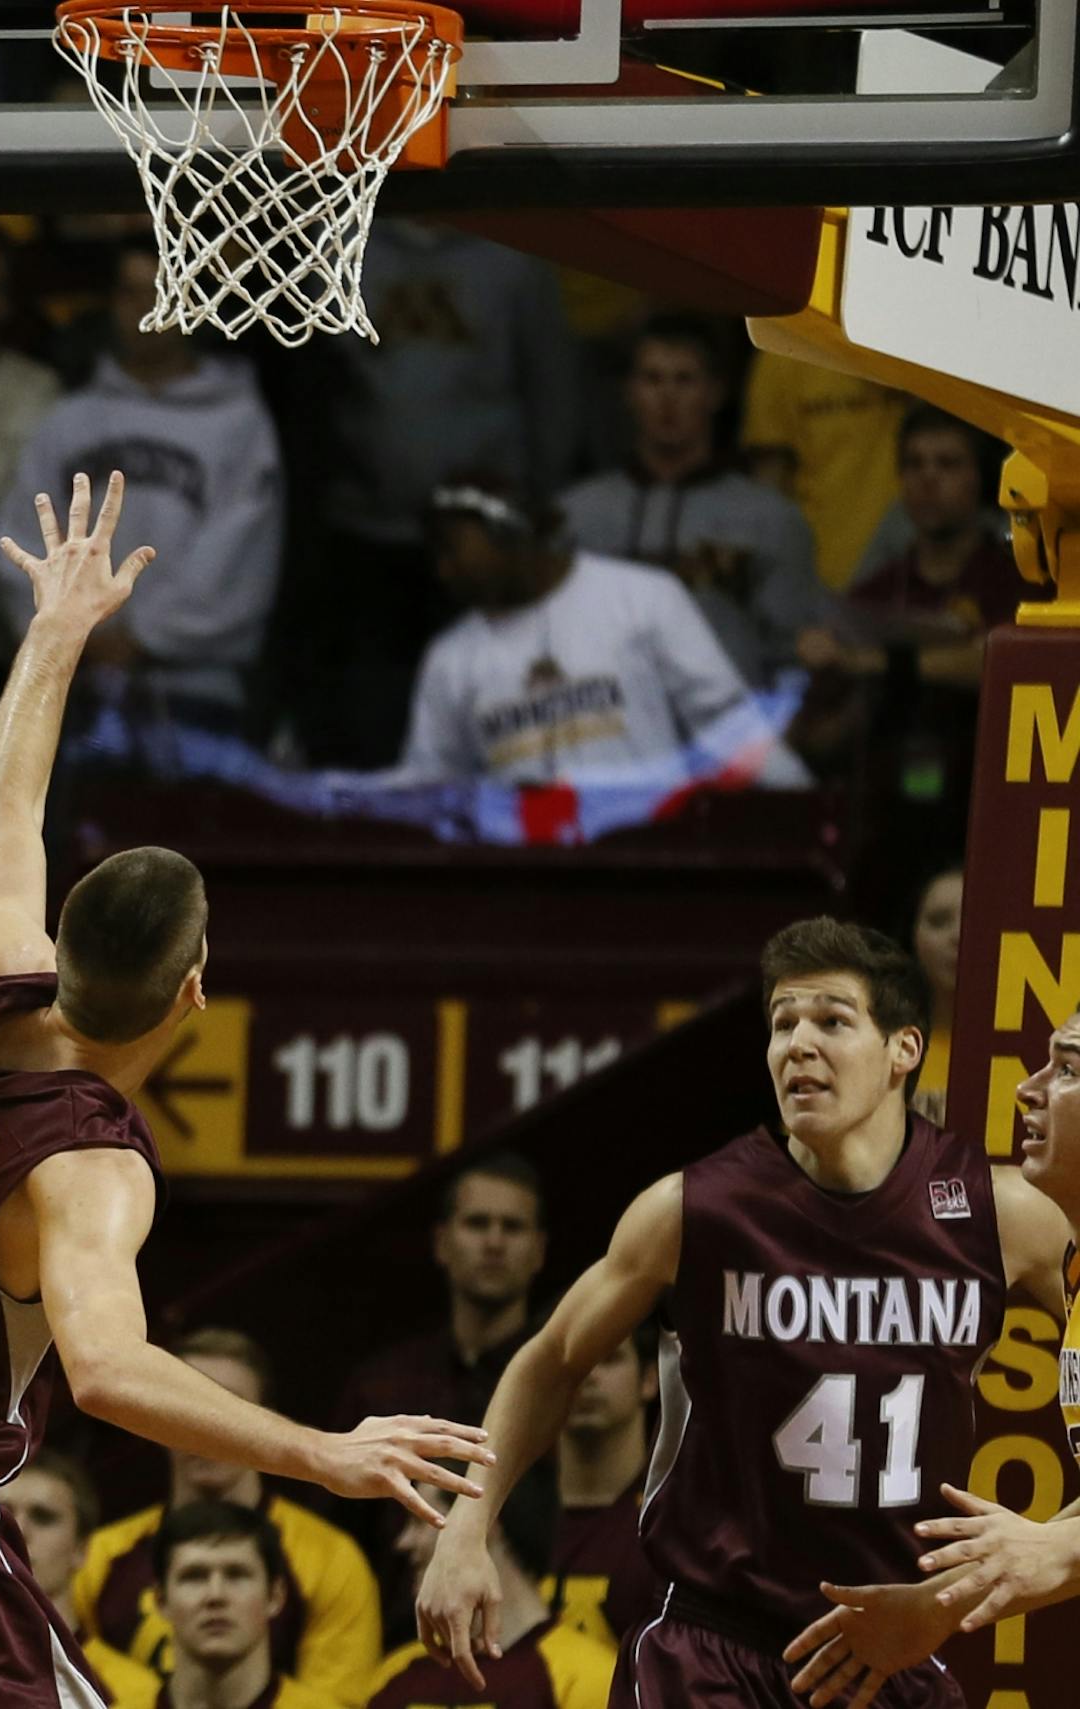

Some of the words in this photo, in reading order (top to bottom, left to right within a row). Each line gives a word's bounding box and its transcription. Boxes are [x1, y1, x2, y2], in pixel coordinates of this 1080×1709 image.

[973, 202, 1080, 312] BAN
[275, 1033, 410, 1129] 110
[722, 1269, 981, 1346] MONTANA
[772, 1373, 926, 1508] 41
